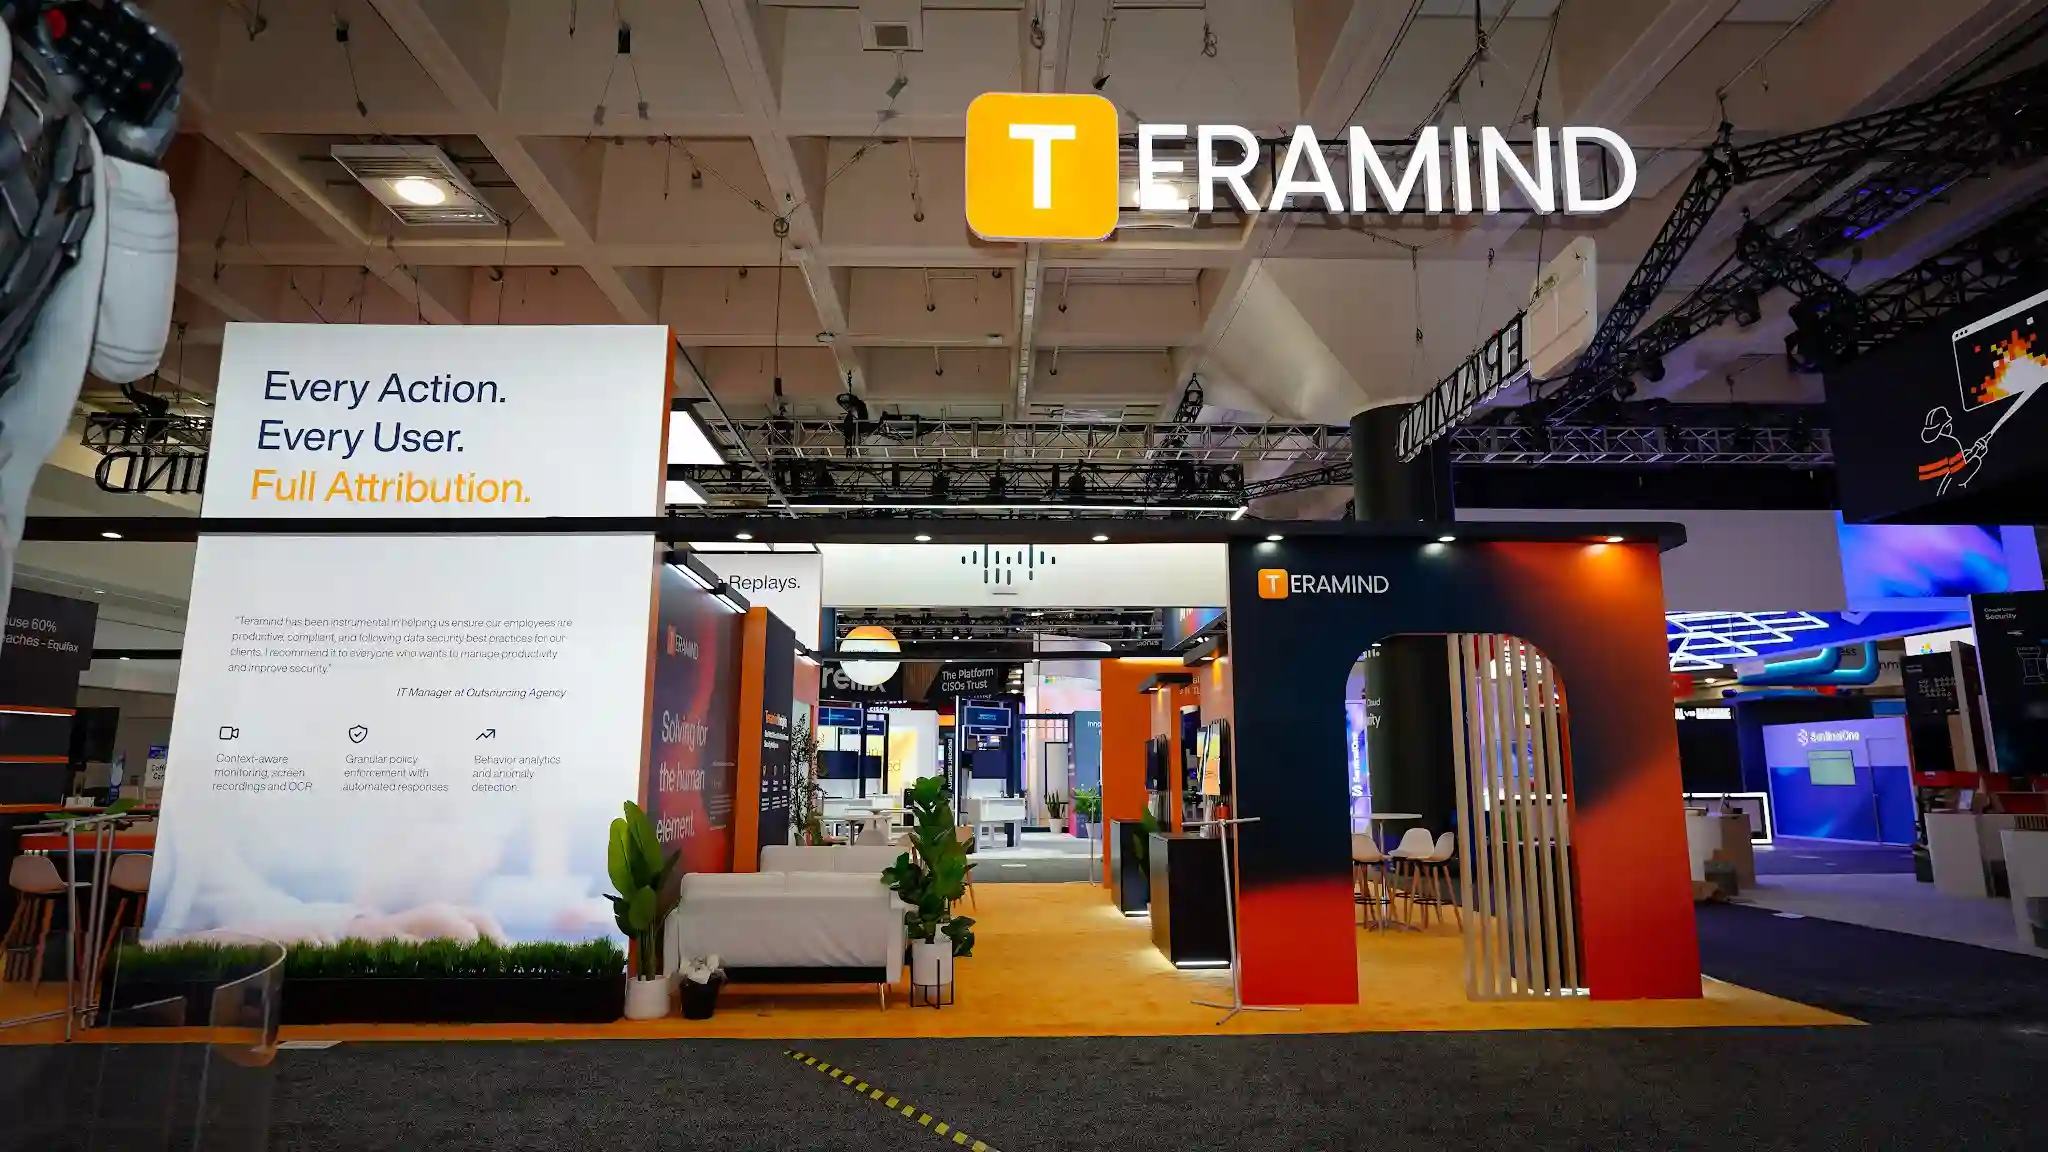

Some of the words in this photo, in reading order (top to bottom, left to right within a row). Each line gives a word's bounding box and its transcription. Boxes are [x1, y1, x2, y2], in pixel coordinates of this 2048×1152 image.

[1007, 122, 1639, 216] TERAMIND
[263, 369, 371, 410] Every
[377, 372, 507, 403] Action.
[257, 419, 365, 460] Every
[373, 421, 464, 452] User.
[250, 468, 317, 501] Full
[323, 470, 531, 503] Attribution.
[729, 574, 801, 593] Replays.
[1265, 574, 1390, 594] TERAMIND
[6, 616, 29, 628] use
[31, 617, 57, 633] 60%
[285, 616, 302, 627] has
[304, 617, 329, 627] been
[330, 617, 389, 628] instrumental
[391, 618, 400, 627] in
[401, 618, 437, 629] helping
[438, 620, 450, 628] us
[451, 620, 484, 628] ensure
[486, 620, 501, 628] our
[503, 618, 556, 629] employees
[557, 620, 573, 628] are
[5, 633, 40, 647] aches
[47, 639, 79, 652] Equifax
[287, 633, 337, 644] compliant,
[338, 633, 357, 643] and
[359, 633, 402, 644] following
[403, 633, 425, 643] data
[426, 633, 463, 644] security
[466, 633, 487, 643] best
[488, 634, 533, 645] practices
[534, 633, 548, 643] for
[549, 635, 566, 643] our
[270, 647, 329, 658] recommend
[330, 648, 337, 657] it
[338, 648, 348, 657] to
[349, 650, 395, 660] everyone
[396, 649, 417, 658] who
[418, 650, 448, 659] wants
[449, 650, 459, 659] to
[460, 652, 500, 660] manage
[501, 649, 559, 660] productivity
[228, 662, 246, 672] and
[248, 663, 288, 674] improve
[942, 671, 957, 680] The
[958, 667, 994, 679] Platform
[941, 681, 965, 691] CISOs
[966, 680, 988, 690] Trust
[396, 687, 408, 697] IT
[408, 687, 452, 699] Manager
[454, 688, 466, 697] at
[466, 687, 527, 699] Outsourcing
[528, 688, 567, 699] Agency
[661, 710, 695, 752] Solving
[696, 718, 709, 746] for
[216, 753, 289, 764] Context-aware
[345, 754, 388, 765] Granular
[389, 754, 419, 766] policy
[474, 755, 517, 765] Behavior
[518, 755, 562, 767] analytics
[214, 767, 269, 779] monitoring,
[271, 769, 305, 778] screen
[343, 768, 407, 778] enforcement
[408, 768, 429, 778] with
[472, 769, 491, 779] and
[493, 769, 535, 780] anomaly
[659, 761, 676, 793] the
[676, 762, 706, 792] human
[212, 781, 266, 793] recordings
[267, 782, 287, 792] and
[288, 782, 313, 792] OCR
[342, 782, 397, 792] automated
[397, 784, 449, 794] responses
[471, 782, 520, 793] detection.
